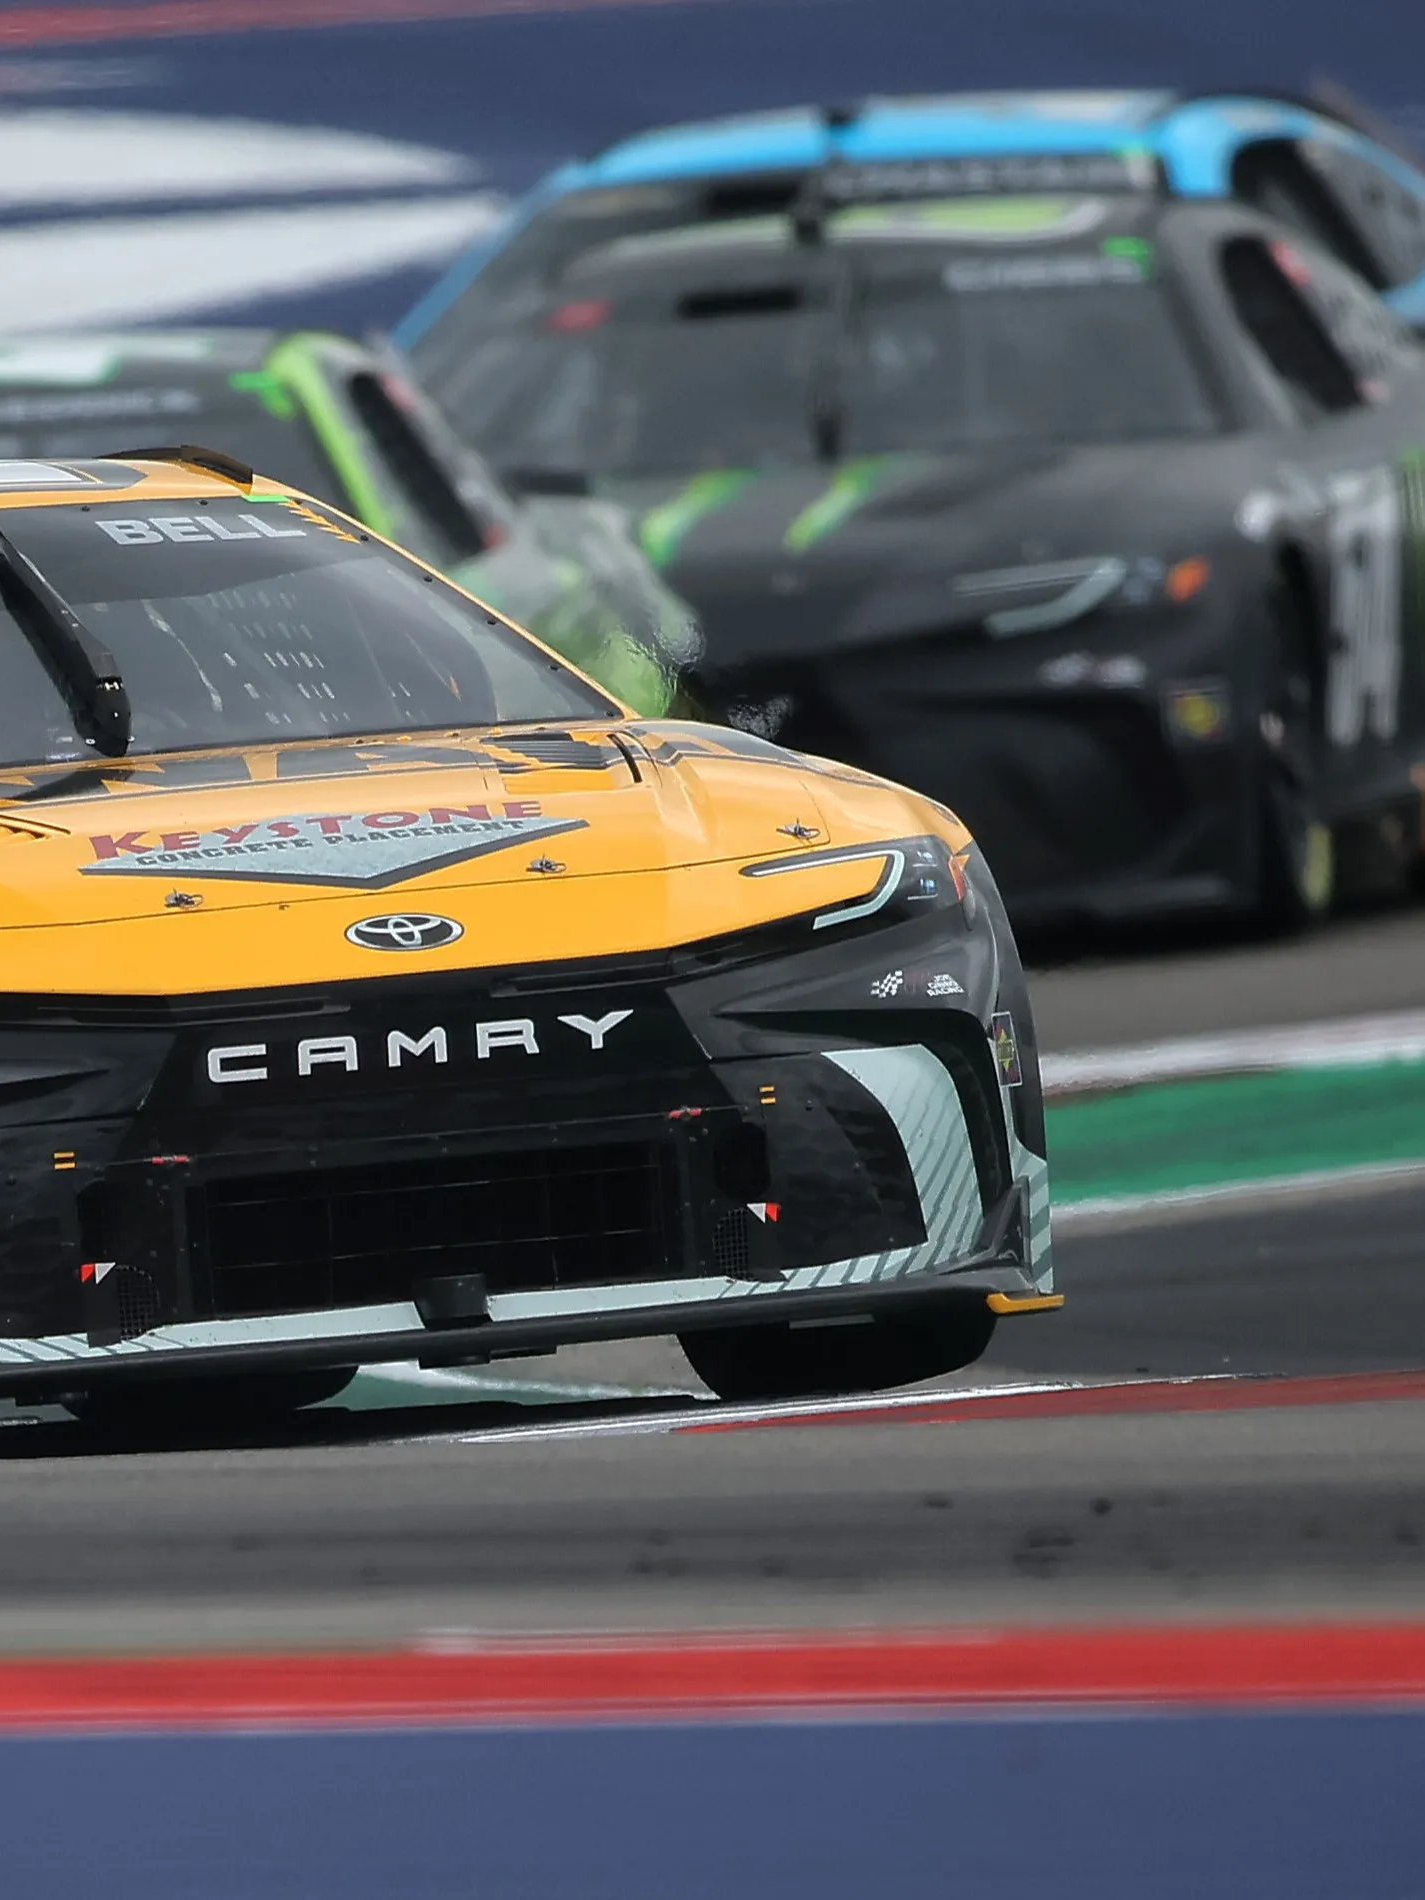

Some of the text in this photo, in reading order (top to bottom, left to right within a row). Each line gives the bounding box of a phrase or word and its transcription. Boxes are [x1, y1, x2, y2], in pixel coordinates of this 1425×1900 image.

[95, 514, 307, 546] BELL
[87, 800, 543, 861] KEYSTONE
[134, 818, 526, 866] CONCRETE PLACEMENT
[206, 1009, 634, 1084] CAMRY
